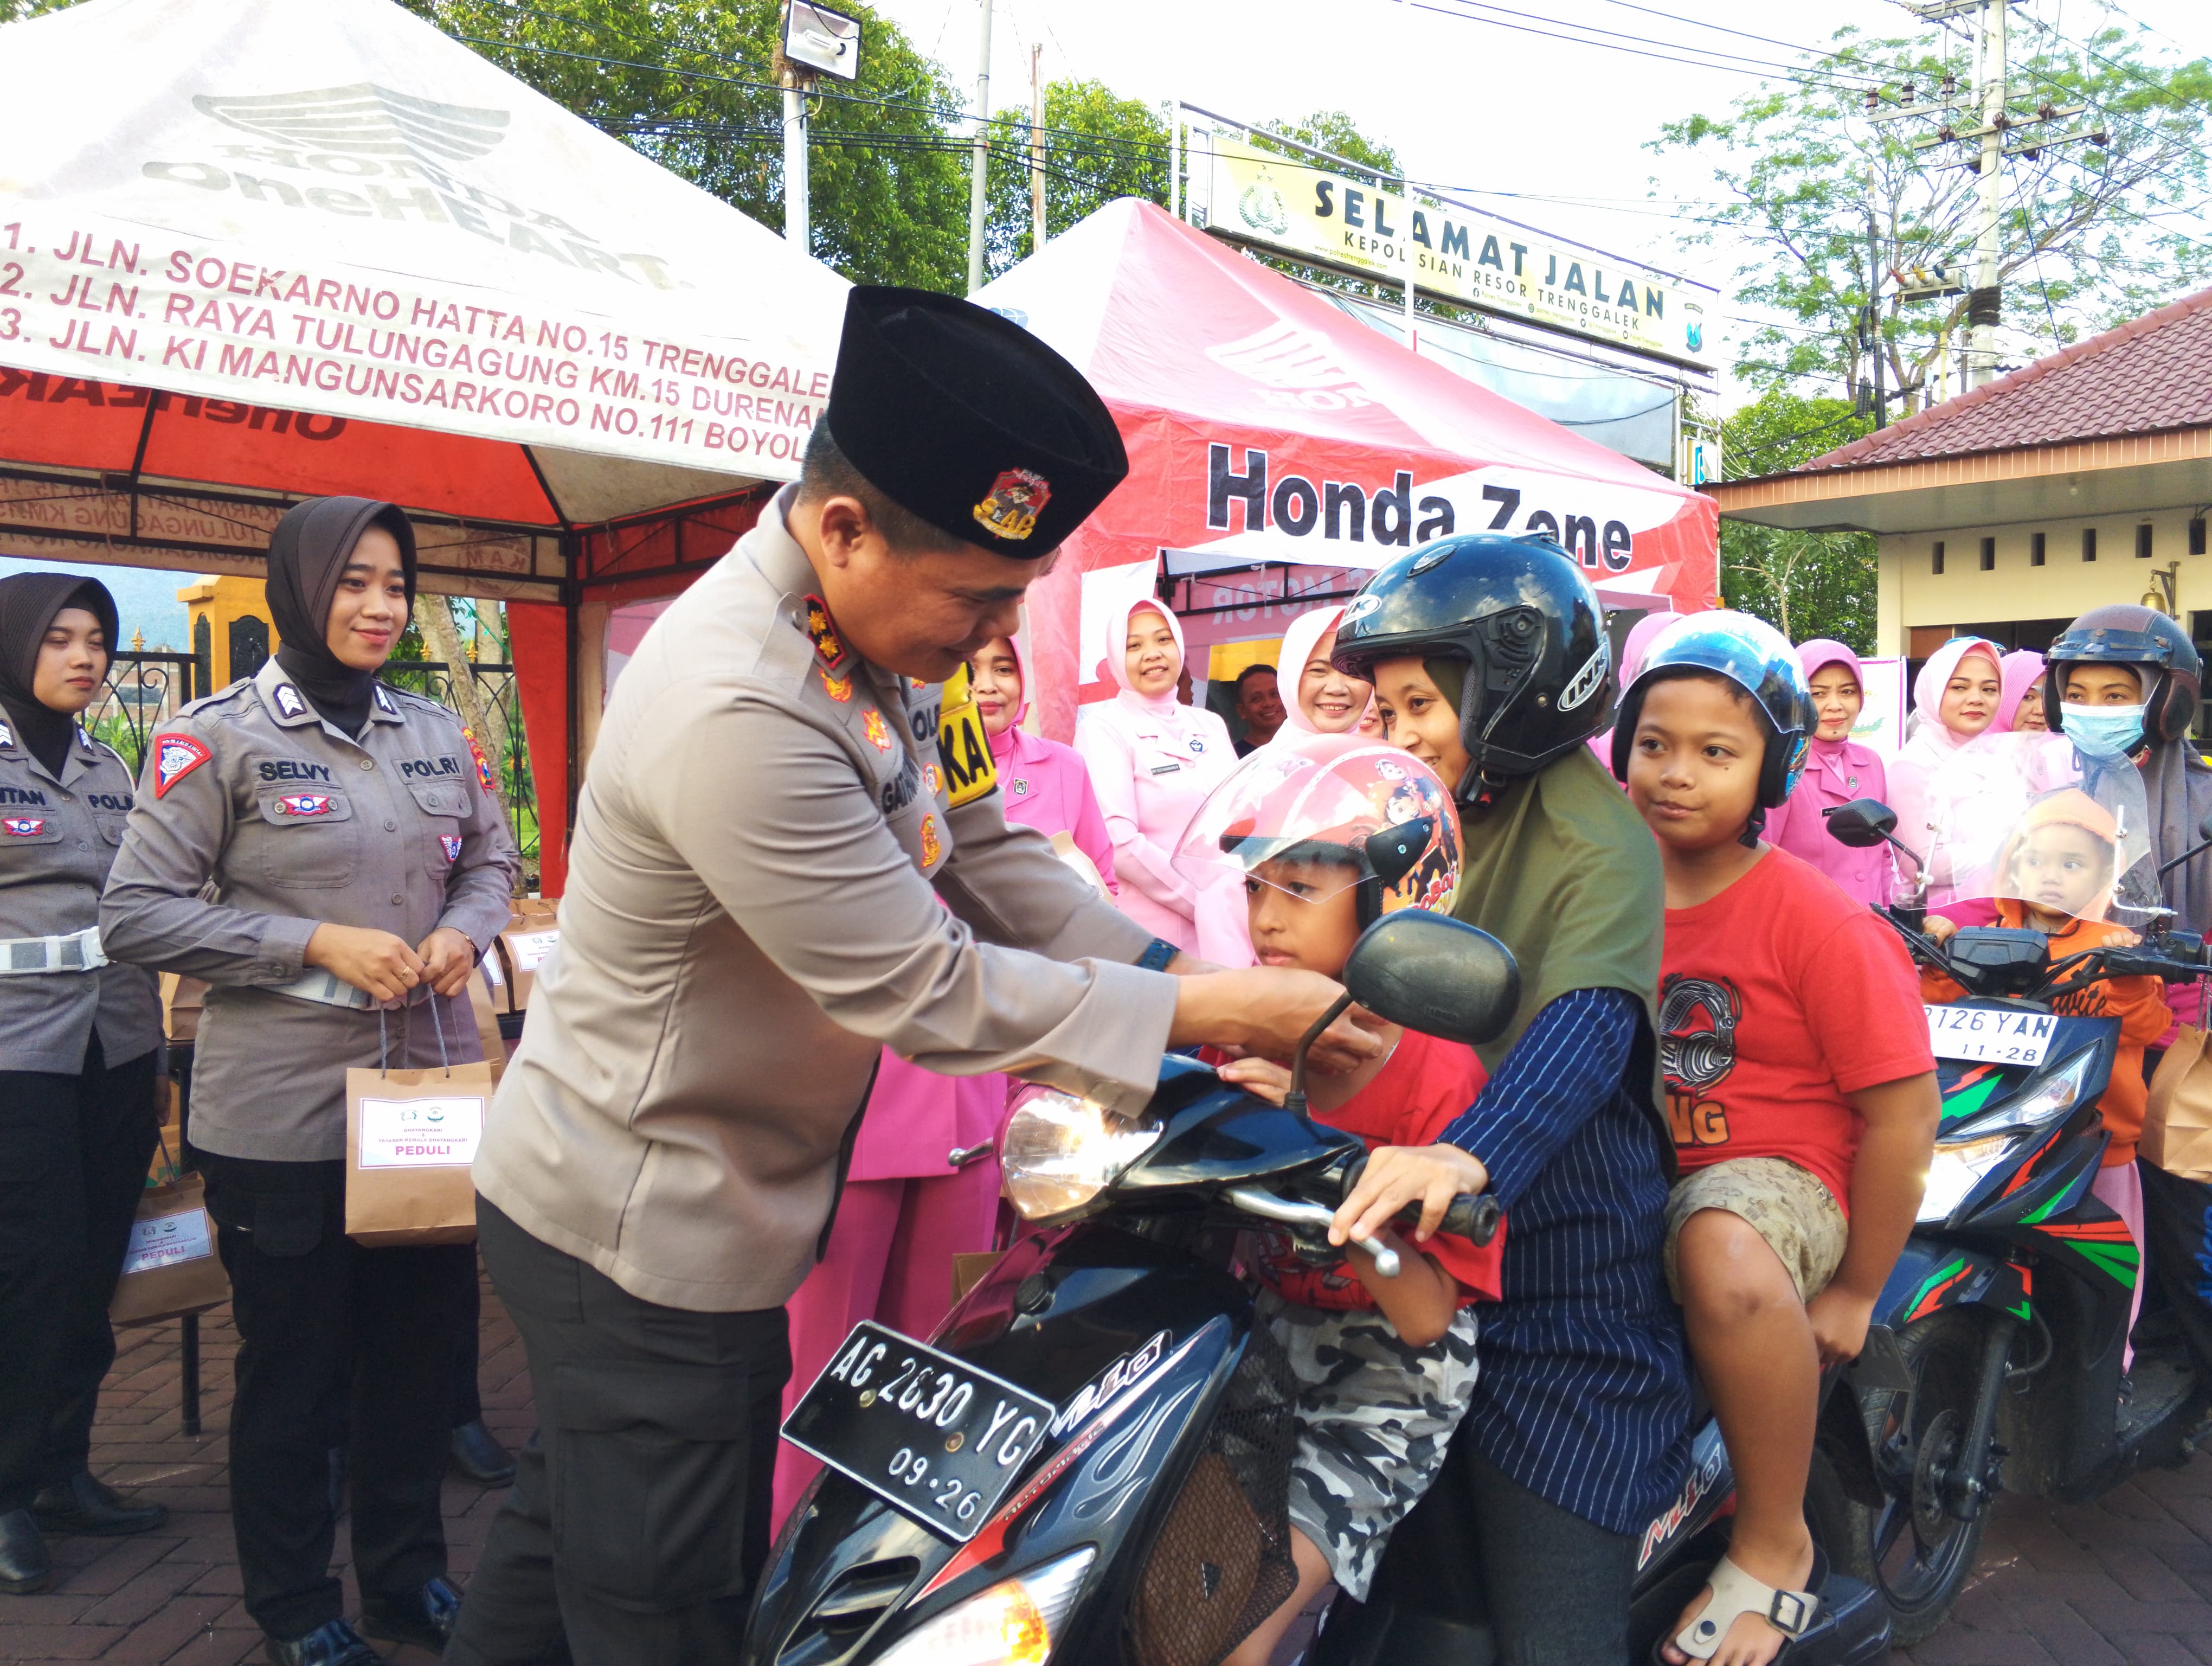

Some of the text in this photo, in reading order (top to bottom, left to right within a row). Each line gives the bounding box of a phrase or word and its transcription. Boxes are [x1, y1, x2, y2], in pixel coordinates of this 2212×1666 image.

[1314, 244, 1388, 270] www.polrestrenggalek.com
[1315, 180, 1663, 320] SELAMAT JALAN
[1345, 231, 1638, 330] KEPOLSIAN RESOR TRENGGALEK
[0, 262, 33, 299] 2.
[50, 274, 146, 319] JLN.
[164, 293, 275, 340] RAYA
[292, 315, 578, 388] TULUNGAGUNG
[589, 367, 680, 406] KM.15
[4, 222, 834, 400] 1. JLN. SOEKARNO HATTA NO.15 TRENGGALE
[0, 307, 31, 343] 3.
[49, 319, 145, 362] JLN.
[163, 336, 208, 371] KI
[218, 344, 580, 426] MANGUNSARKORO
[590, 403, 695, 444] NO.111
[1207, 441, 1455, 548] Honda
[259, 758, 461, 782] SELVY POLRI
[1997, 1013, 2053, 1038] YAN
[395, 1145, 451, 1156] PEDULI
[141, 1246, 185, 1261] PEDULI
[830, 1336, 887, 1387] AG
[878, 1357, 973, 1427] 2630
